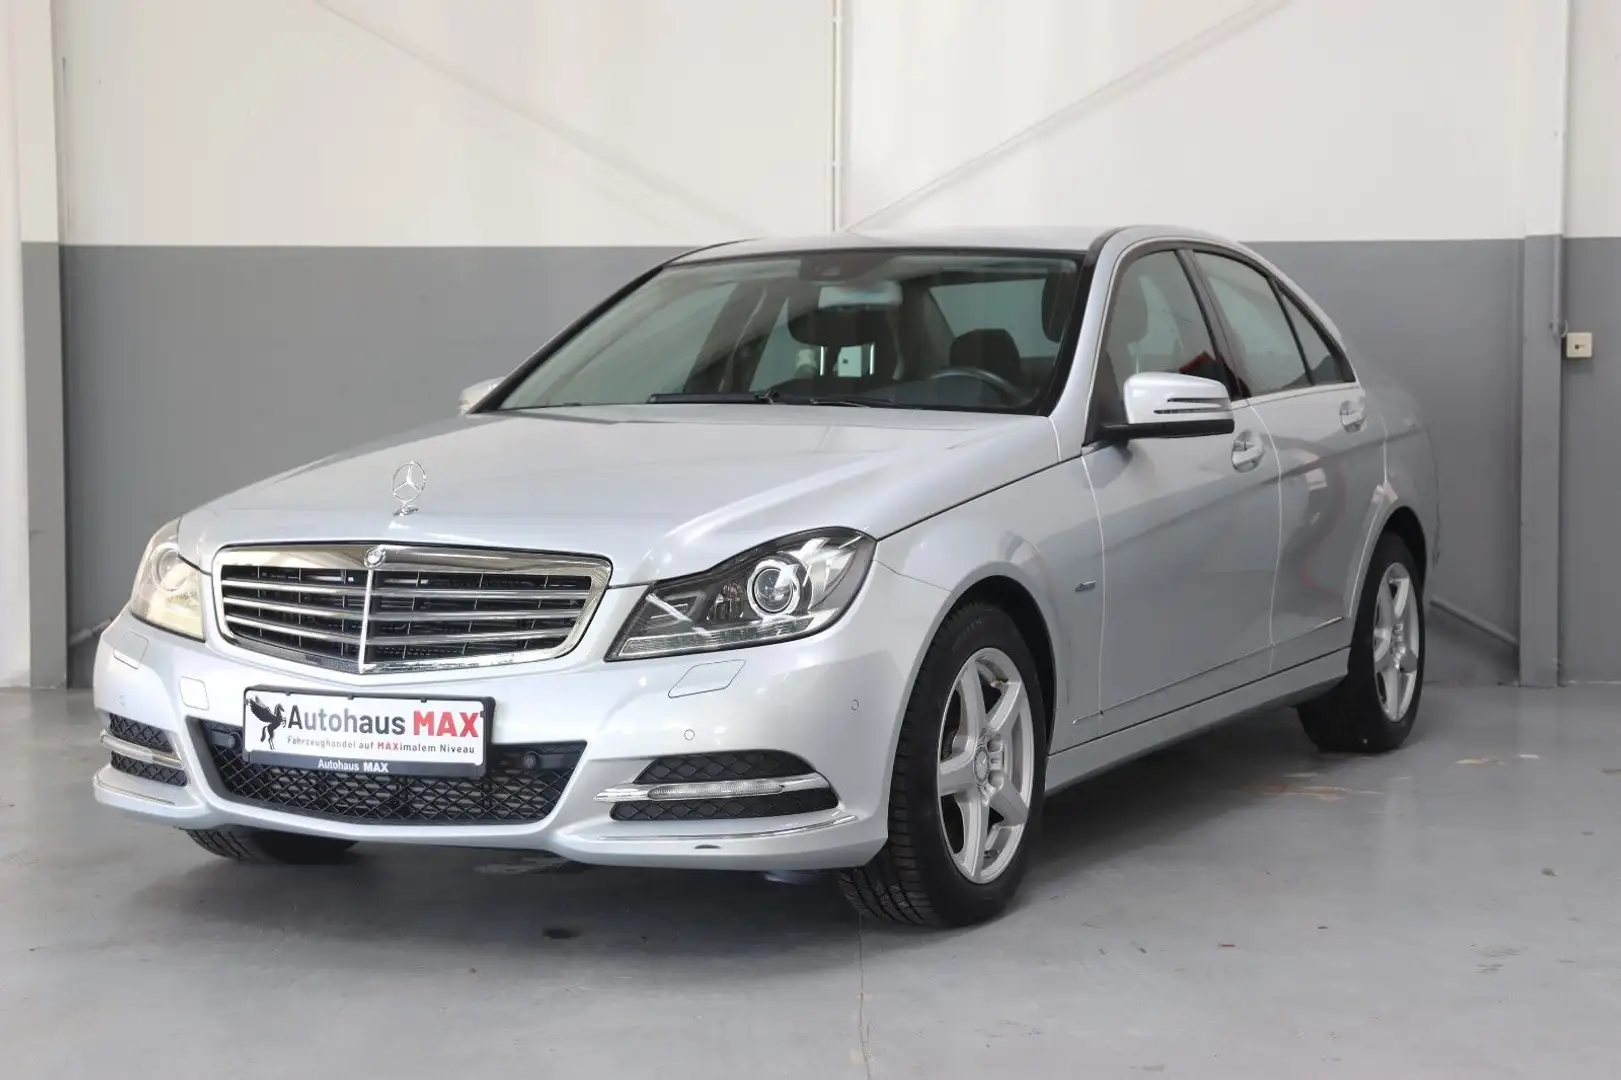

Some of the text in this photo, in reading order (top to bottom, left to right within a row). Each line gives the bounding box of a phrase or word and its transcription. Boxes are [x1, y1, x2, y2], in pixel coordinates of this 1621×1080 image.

[288, 705, 479, 738] Autohaus MAX
[287, 735, 475, 754] Fahrzeughandel auf MAXimalem Niveau
[318, 758, 389, 773] Autohaus MAX
